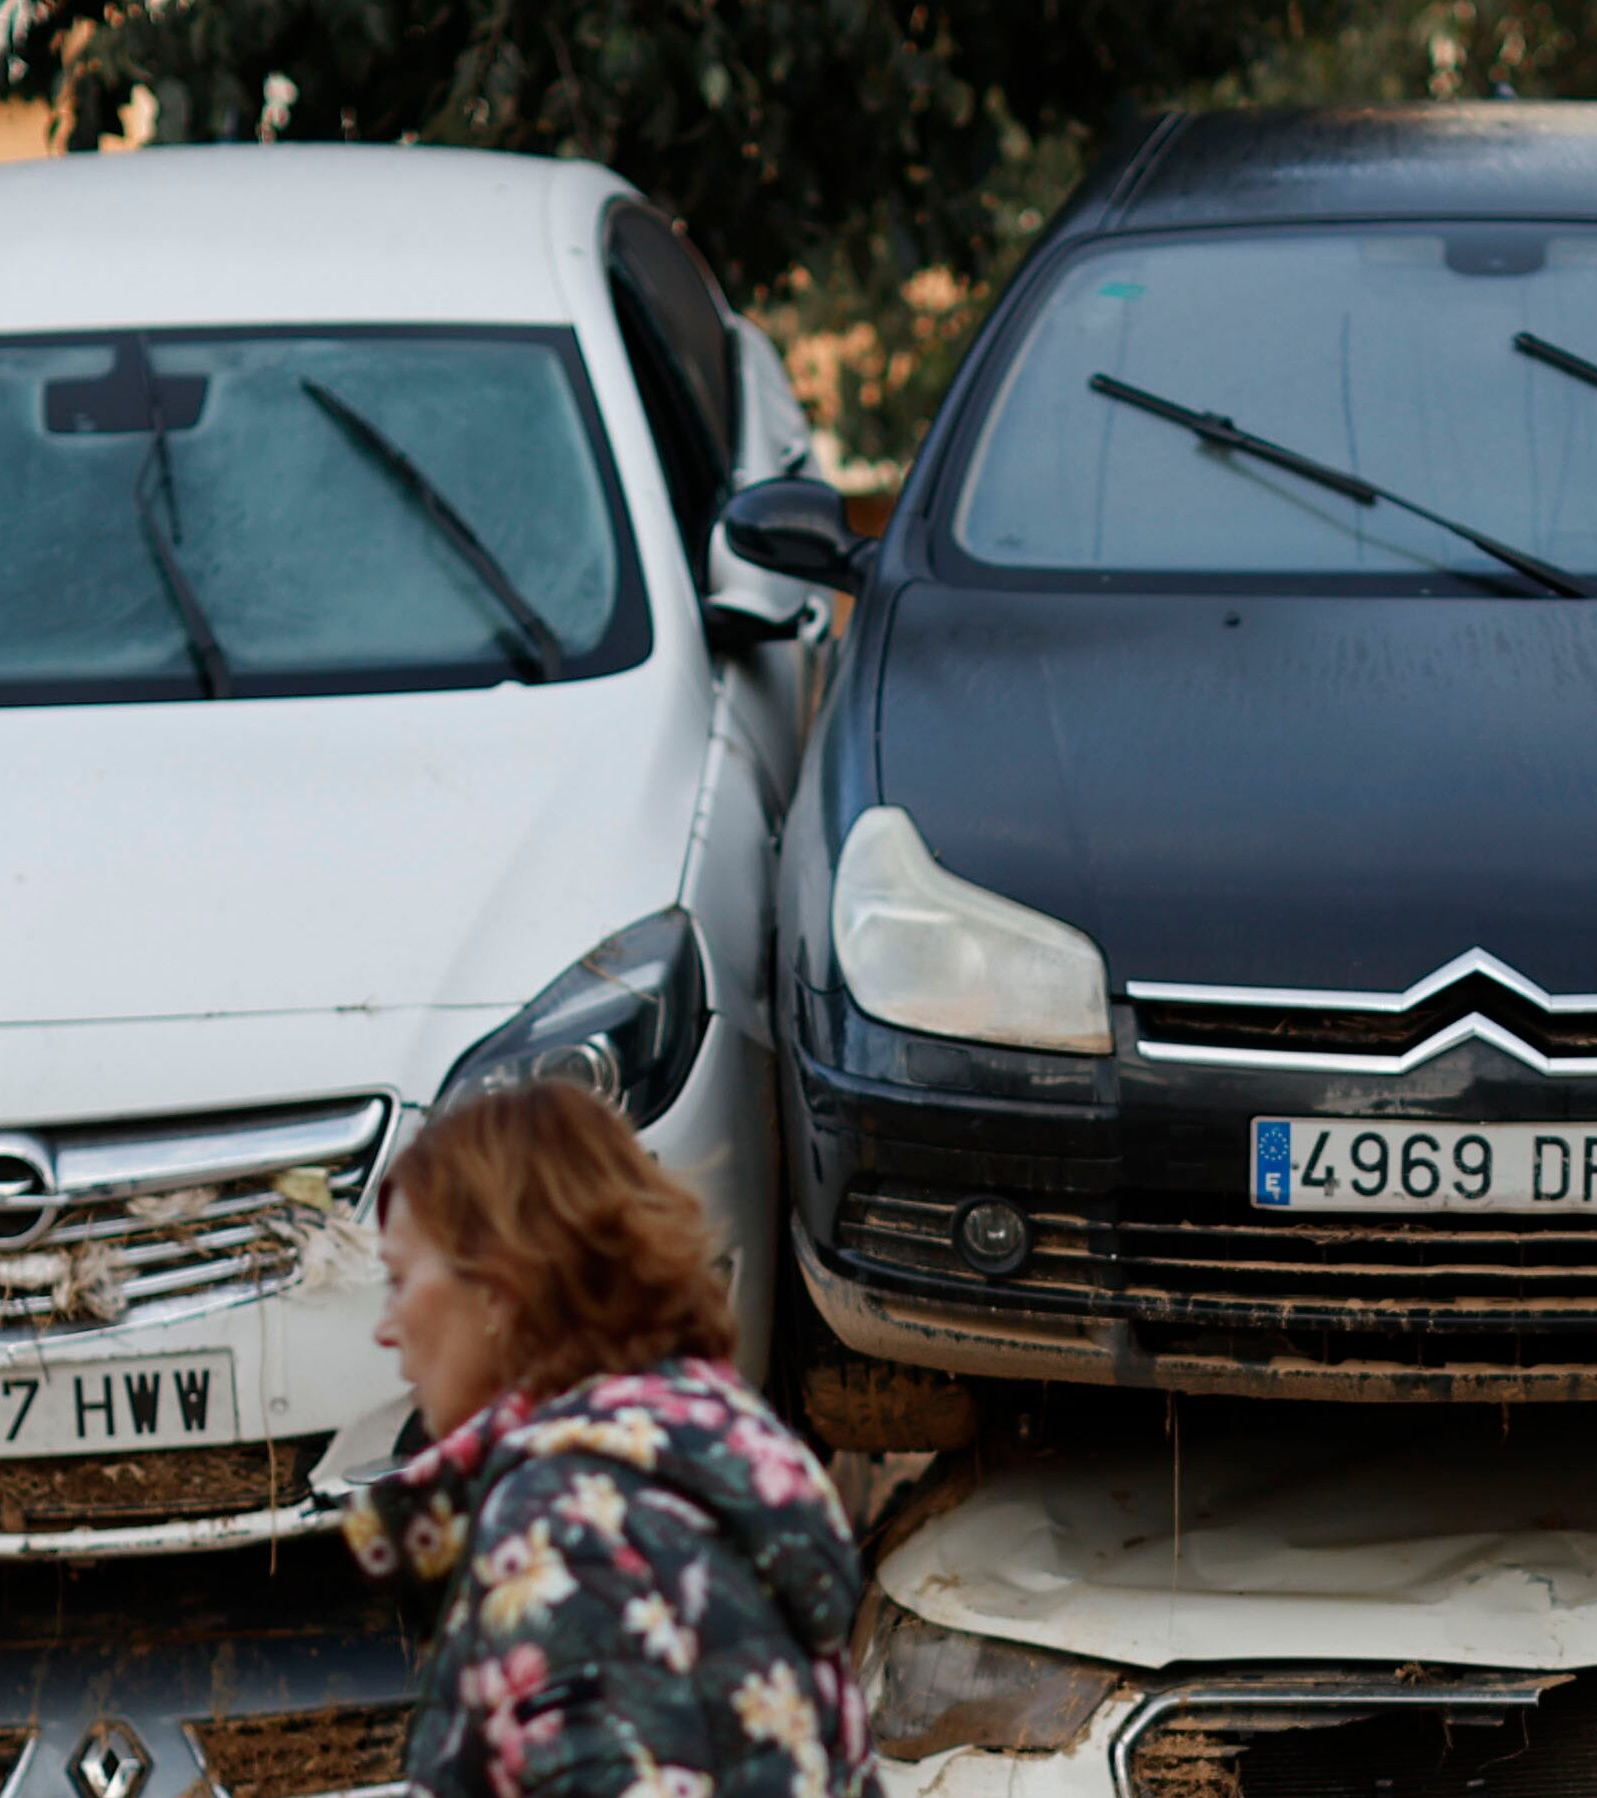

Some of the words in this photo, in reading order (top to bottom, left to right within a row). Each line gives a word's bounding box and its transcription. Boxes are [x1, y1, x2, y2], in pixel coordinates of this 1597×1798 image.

[1266, 1172, 1282, 1193] E
[1301, 1130, 1493, 1200] 4969
[74, 1369, 210, 1438] HWW
